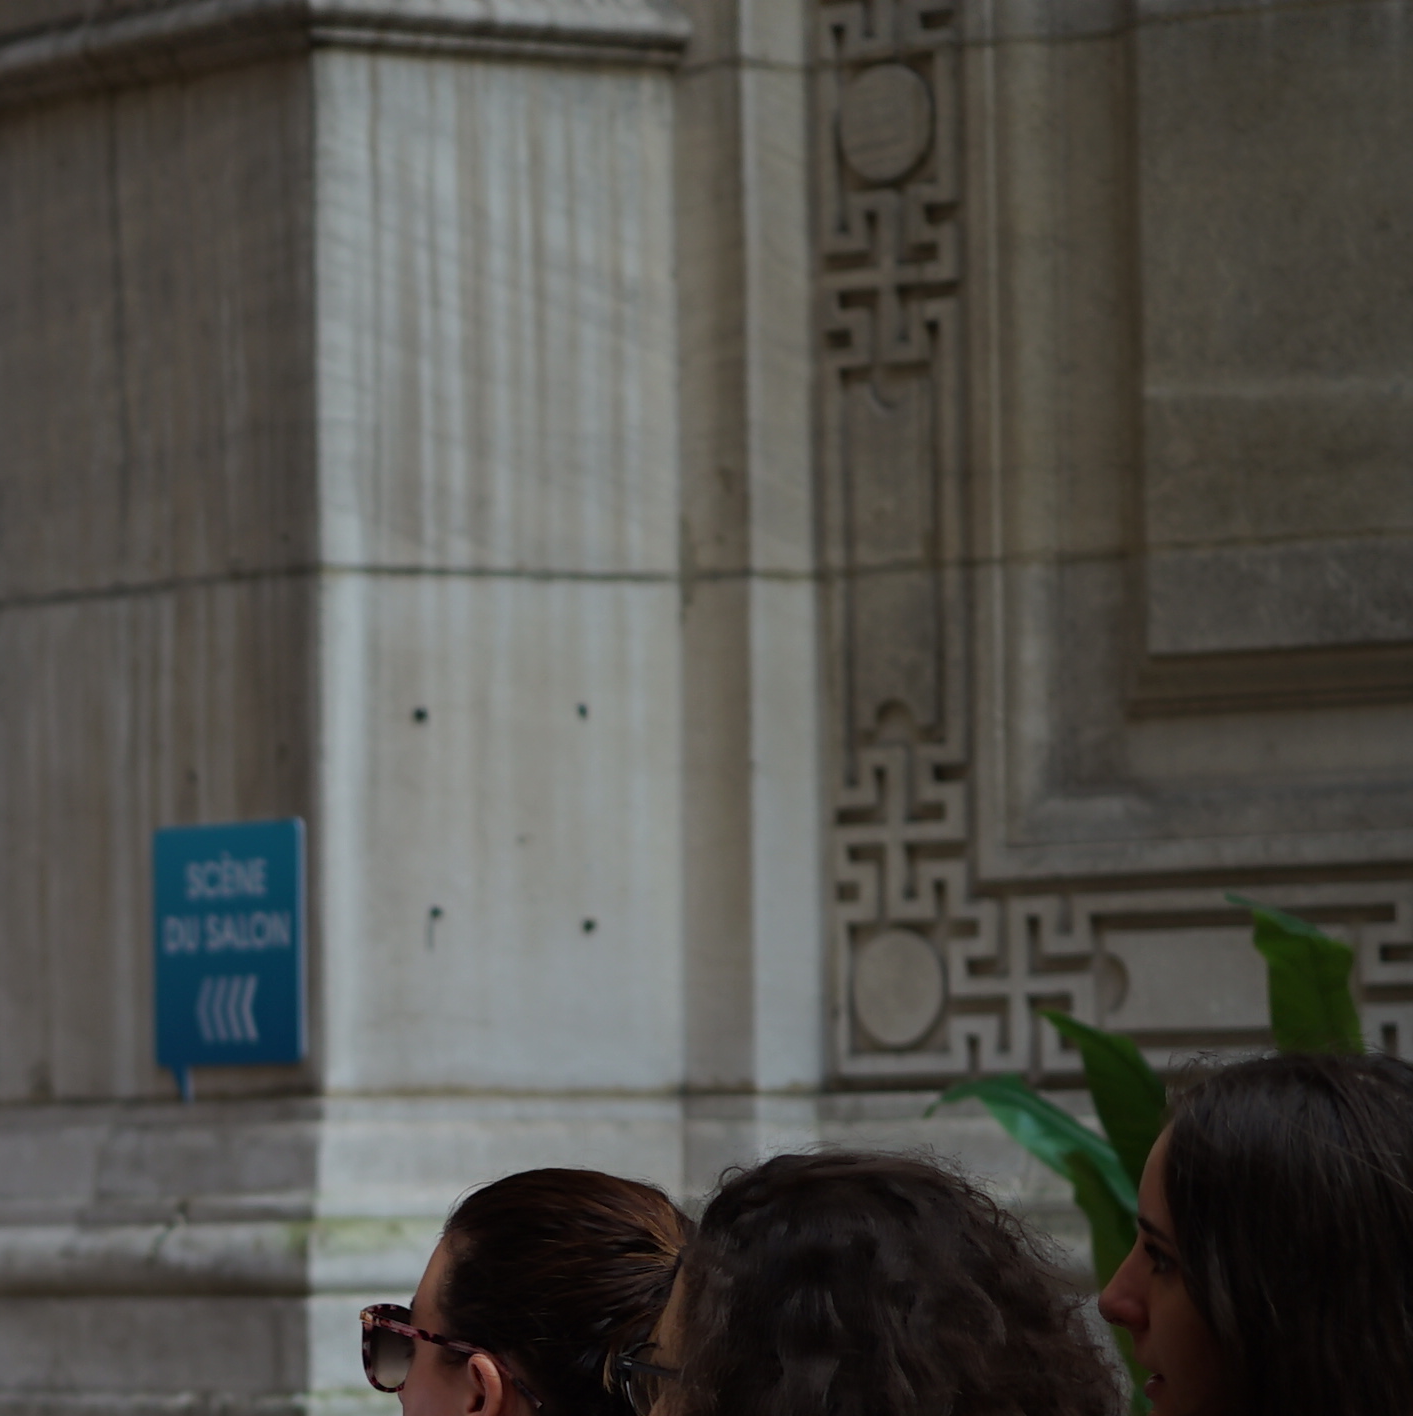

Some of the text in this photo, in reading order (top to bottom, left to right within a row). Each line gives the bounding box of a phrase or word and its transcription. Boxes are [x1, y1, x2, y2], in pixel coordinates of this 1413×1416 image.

[184, 850, 268, 898] SCÈNE
[164, 910, 291, 954] DU SALON
